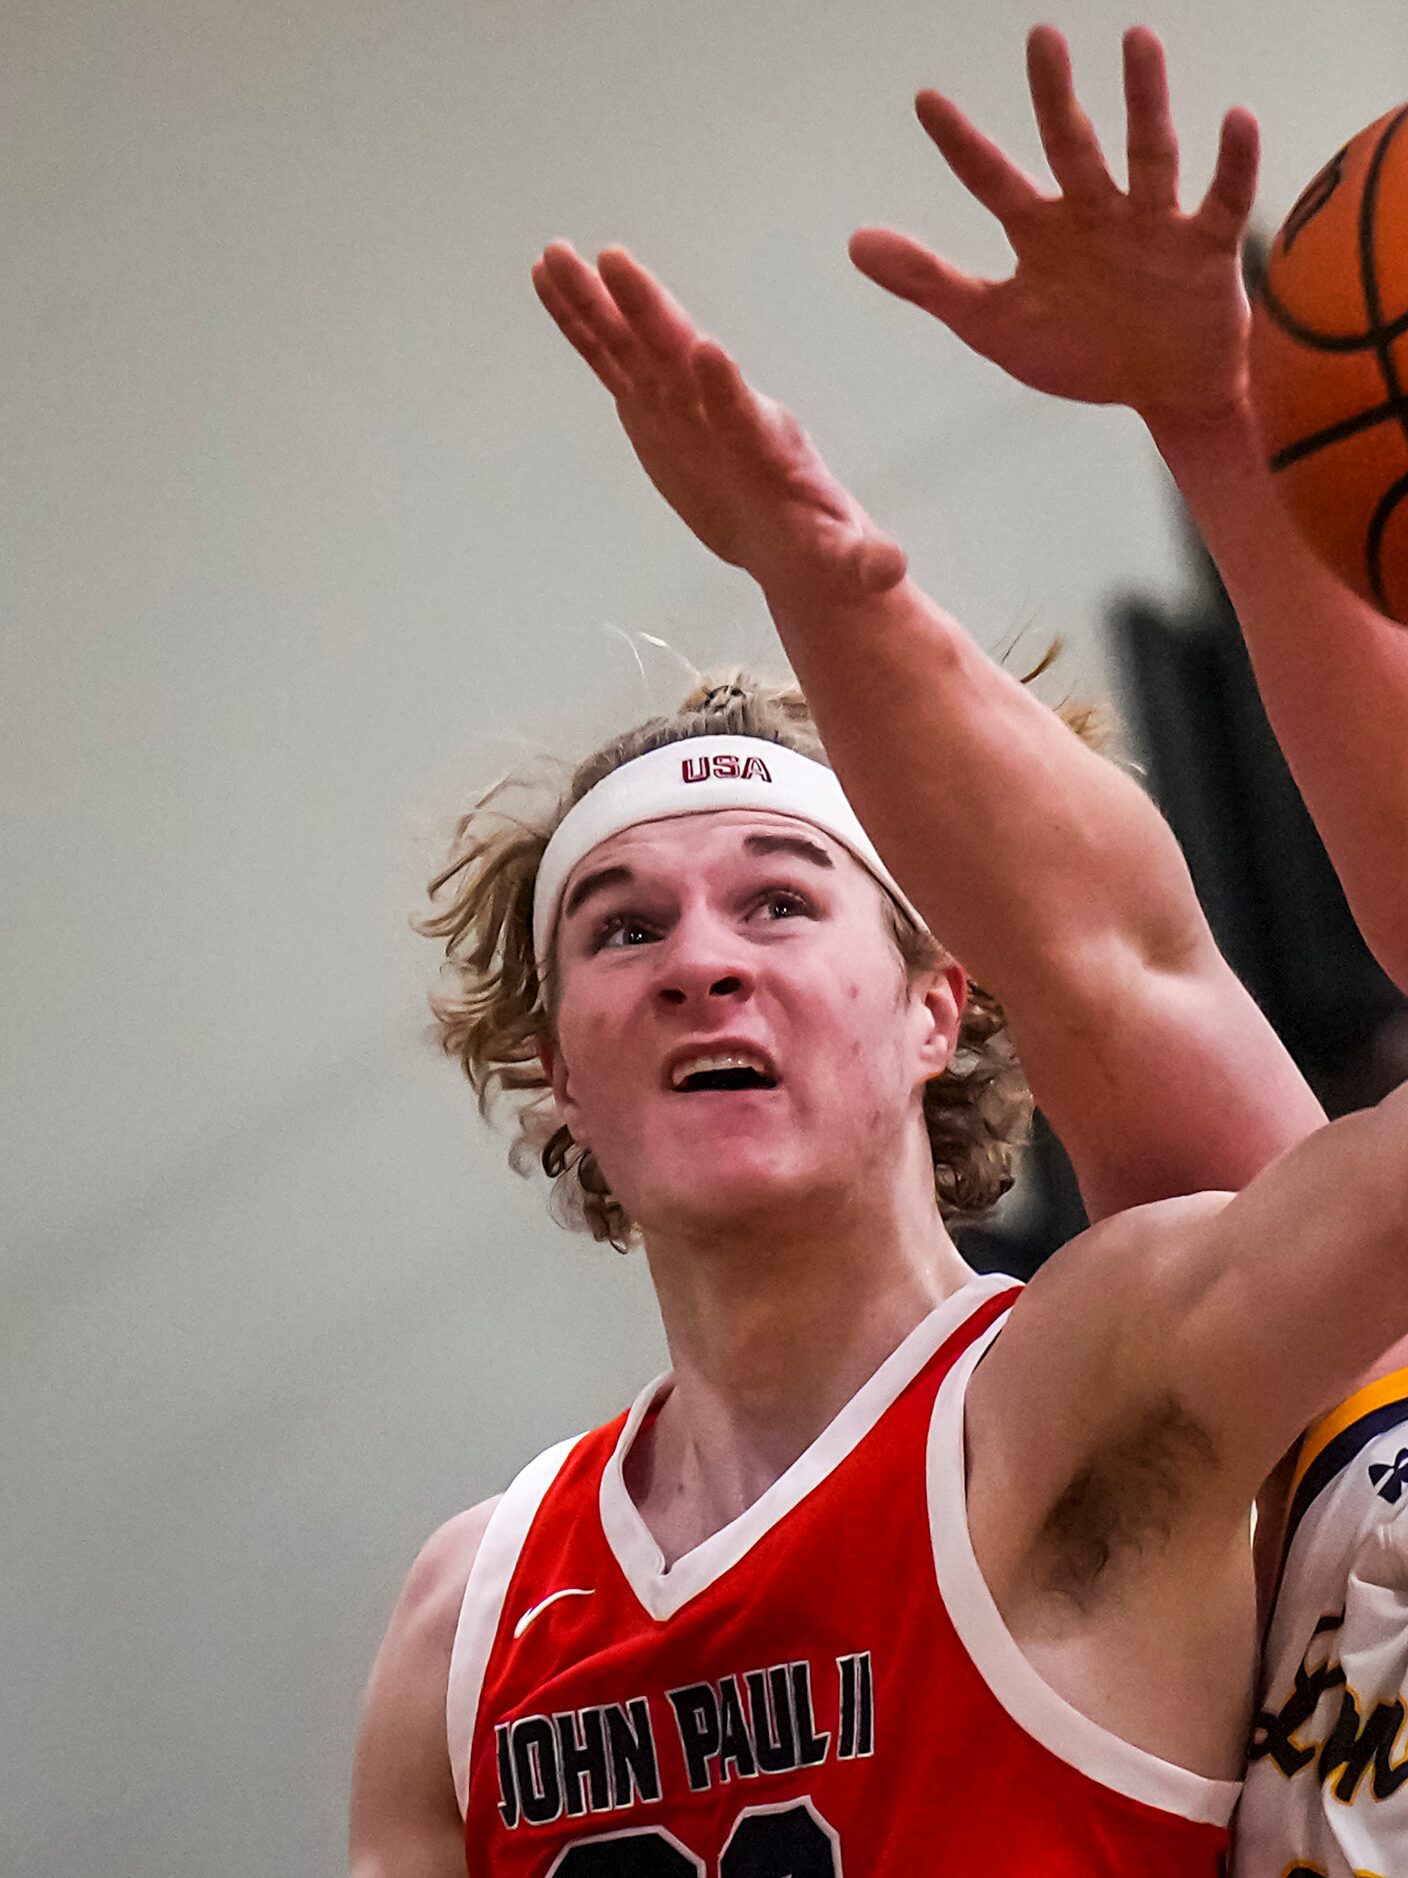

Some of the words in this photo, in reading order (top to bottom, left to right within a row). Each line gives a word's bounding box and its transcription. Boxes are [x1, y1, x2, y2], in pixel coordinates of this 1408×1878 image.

[682, 755, 773, 784] USA
[494, 1696, 663, 1830] JOHN
[664, 1660, 831, 1792] PAUL
[836, 1651, 875, 1761] II
